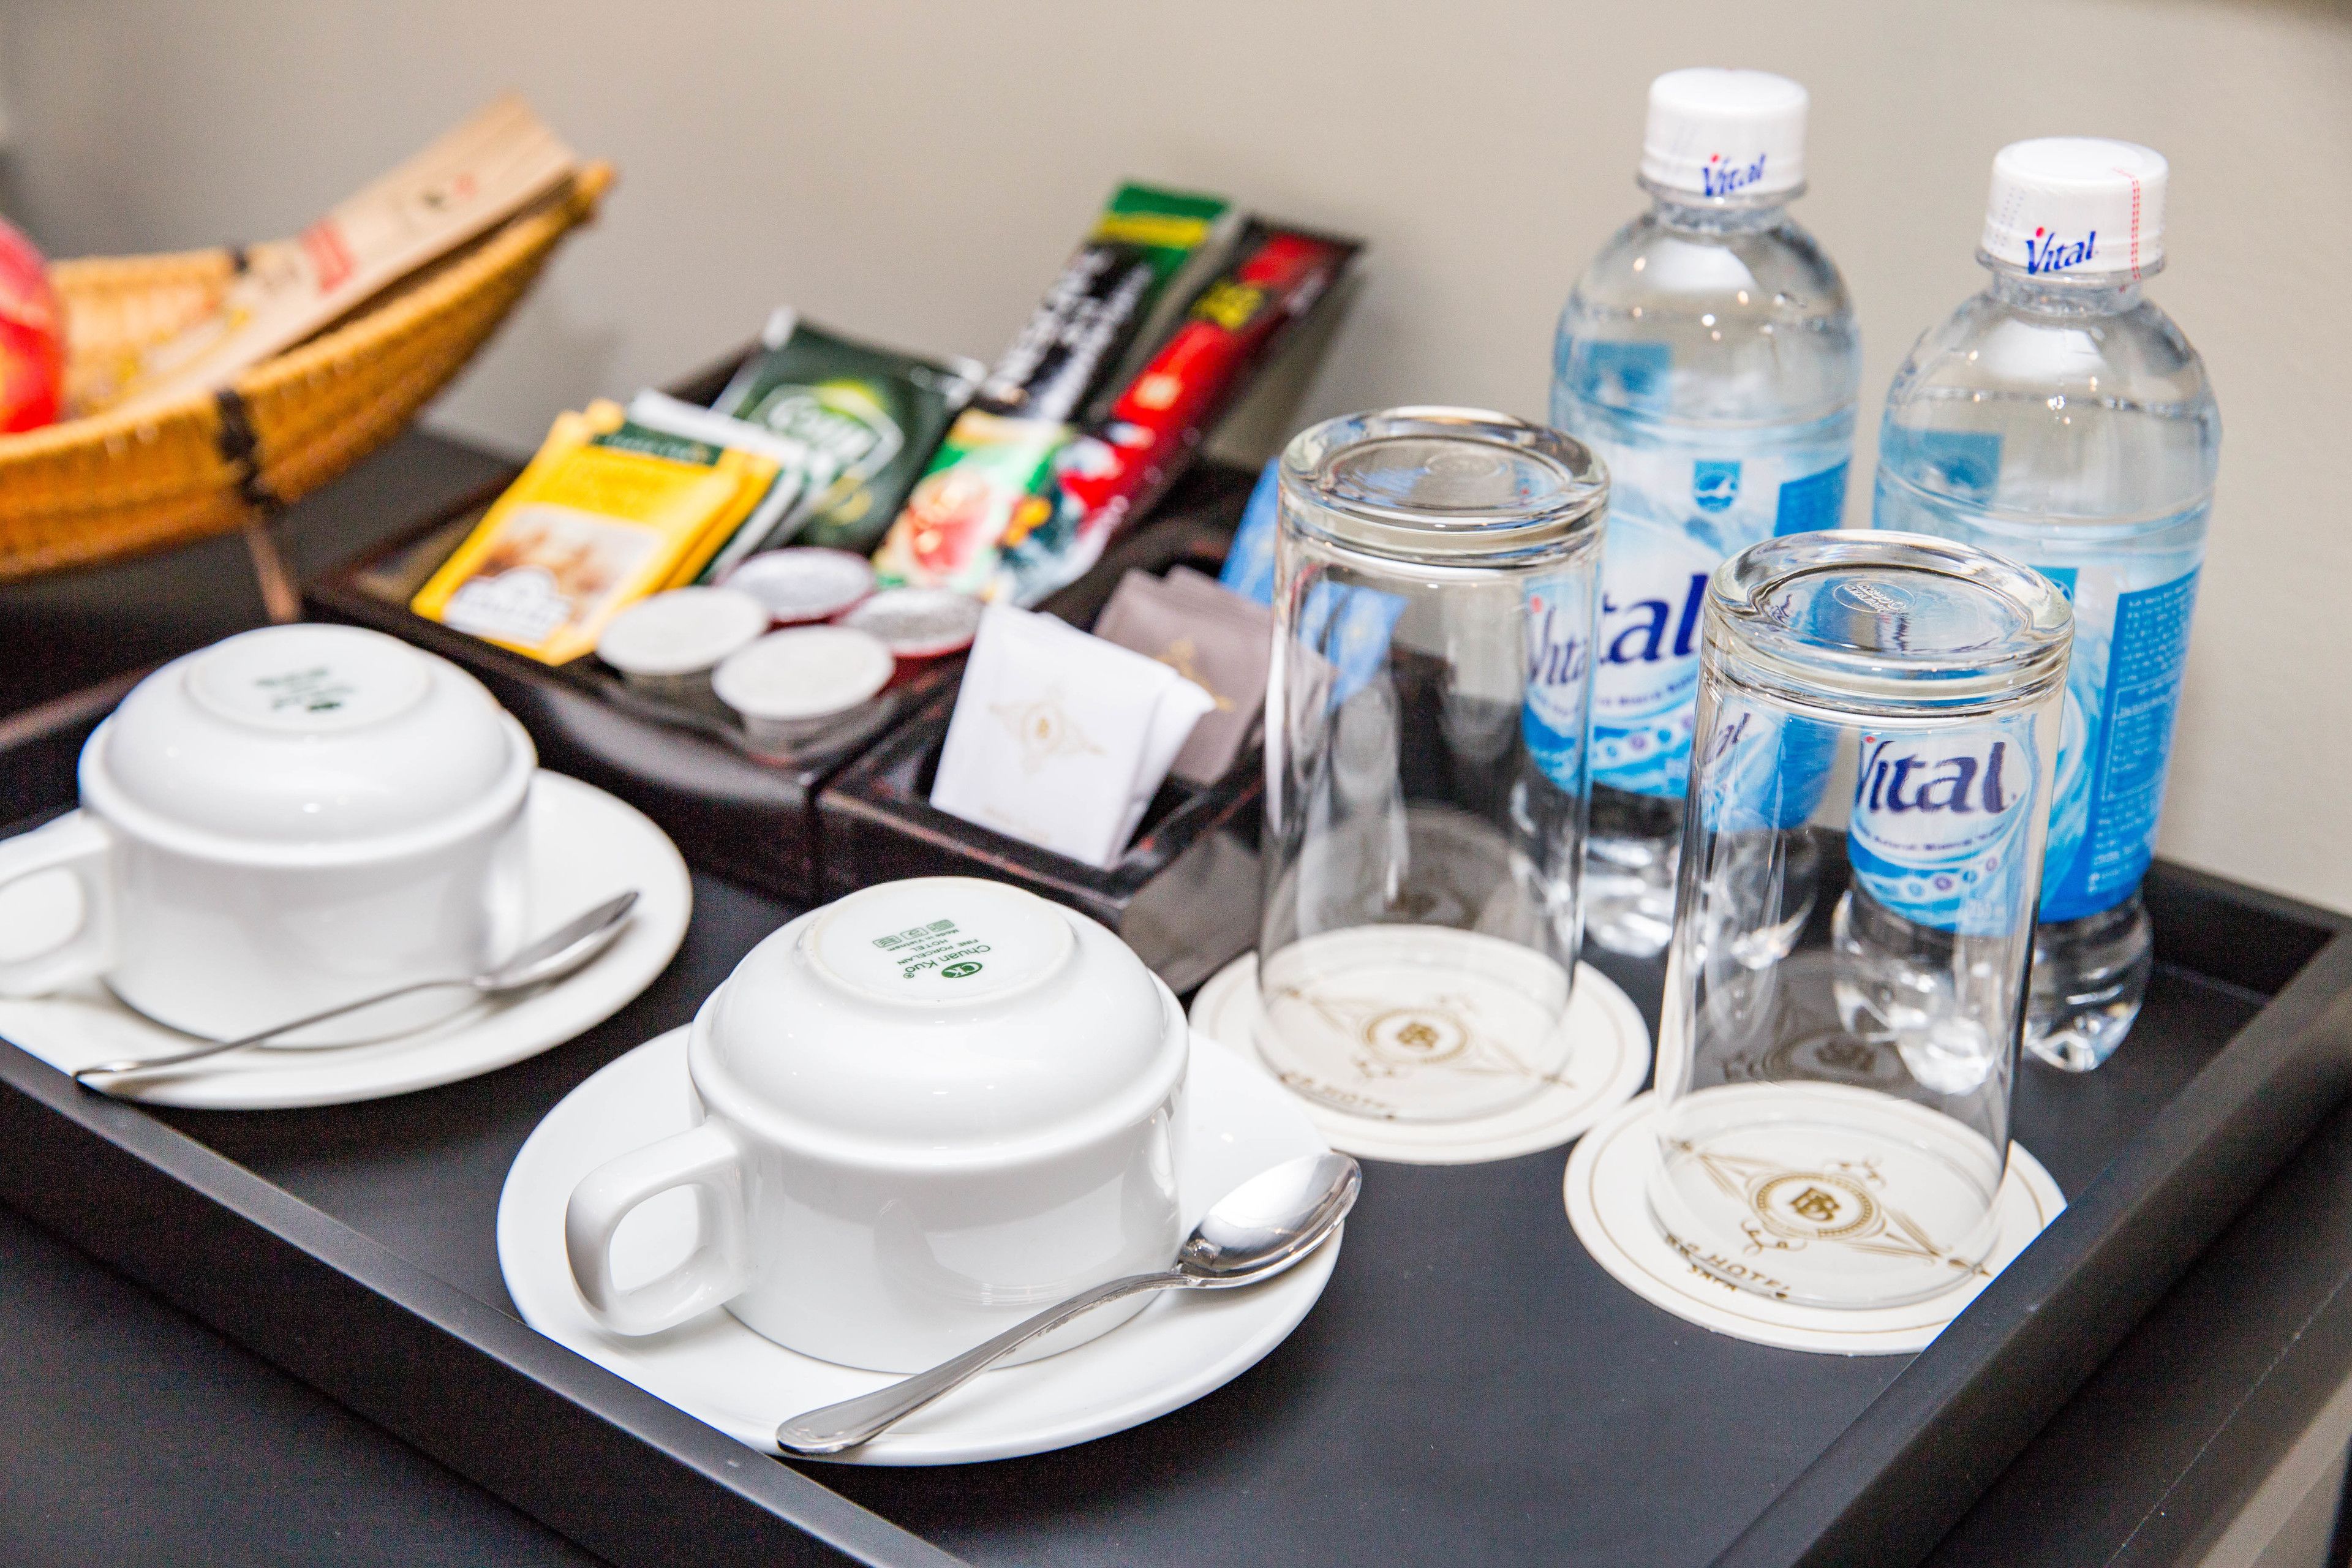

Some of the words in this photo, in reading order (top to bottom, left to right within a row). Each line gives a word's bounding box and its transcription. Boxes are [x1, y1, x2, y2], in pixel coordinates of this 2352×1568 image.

[1702, 154, 1766, 198] Vital
[2026, 227, 2097, 275] Vital
[936, 929, 960, 938] Made
[887, 937, 925, 952] Vietnam
[910, 939, 948, 951] HOTEL
[957, 939, 979, 948] FINE
[897, 945, 954, 965] PORCELAIN
[938, 945, 990, 962] Chuan
